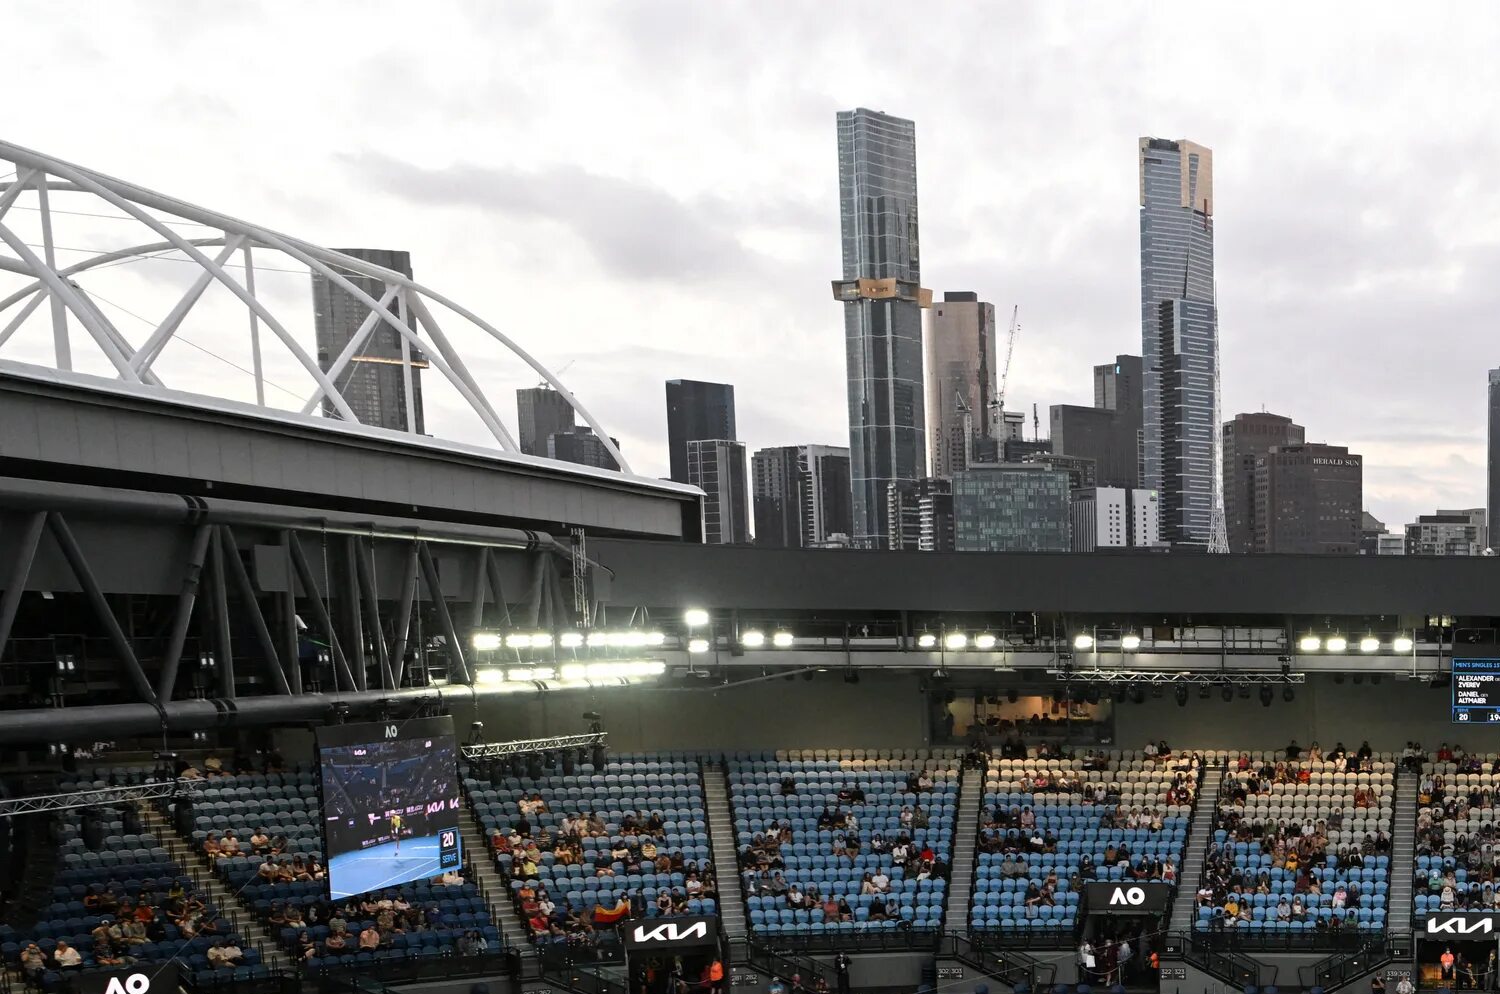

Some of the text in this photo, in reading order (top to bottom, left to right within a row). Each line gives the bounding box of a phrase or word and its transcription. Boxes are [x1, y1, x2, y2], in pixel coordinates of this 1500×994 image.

[385, 725, 397, 738] AO
[427, 801, 445, 815] KIA
[442, 831, 454, 847] 20
[442, 852, 457, 864] SERVE
[1110, 887, 1145, 905] AO
[634, 922, 706, 942] KIA
[1428, 918, 1492, 933] KIA
